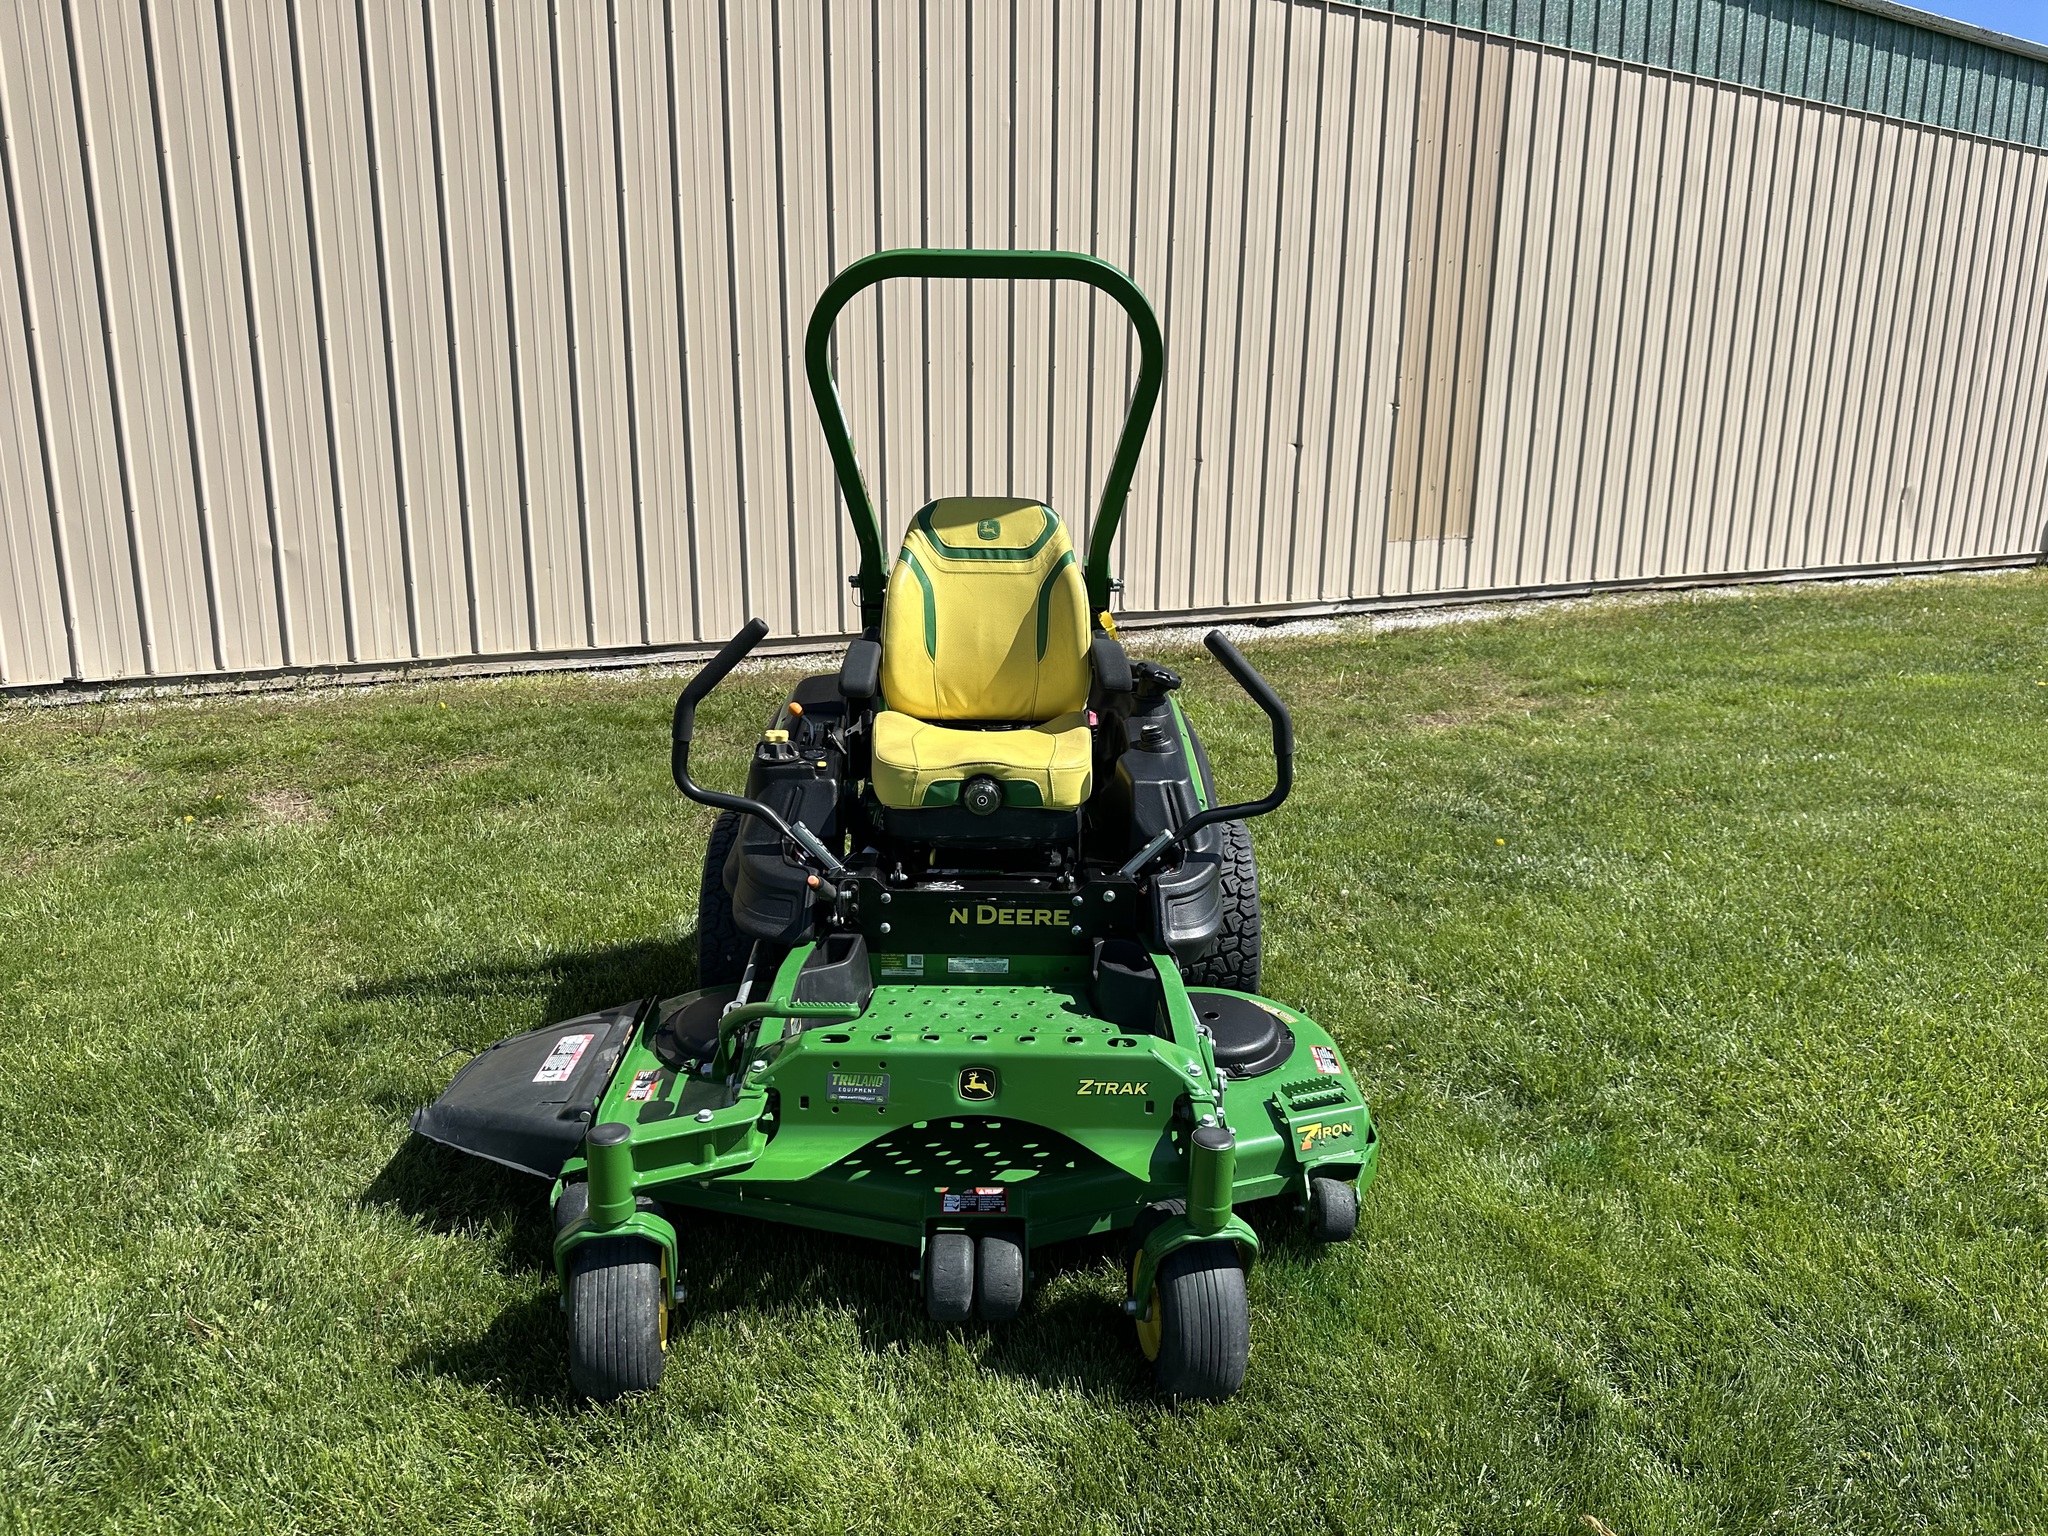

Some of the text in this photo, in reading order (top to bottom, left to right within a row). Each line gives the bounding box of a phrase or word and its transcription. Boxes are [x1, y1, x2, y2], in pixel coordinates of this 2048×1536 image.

[976, 904, 1071, 926] DEERE
[832, 1073, 884, 1088] TRULAND
[1076, 1079, 1150, 1096] ZTRAK
[838, 1086, 877, 1094] EQUIPMENT
